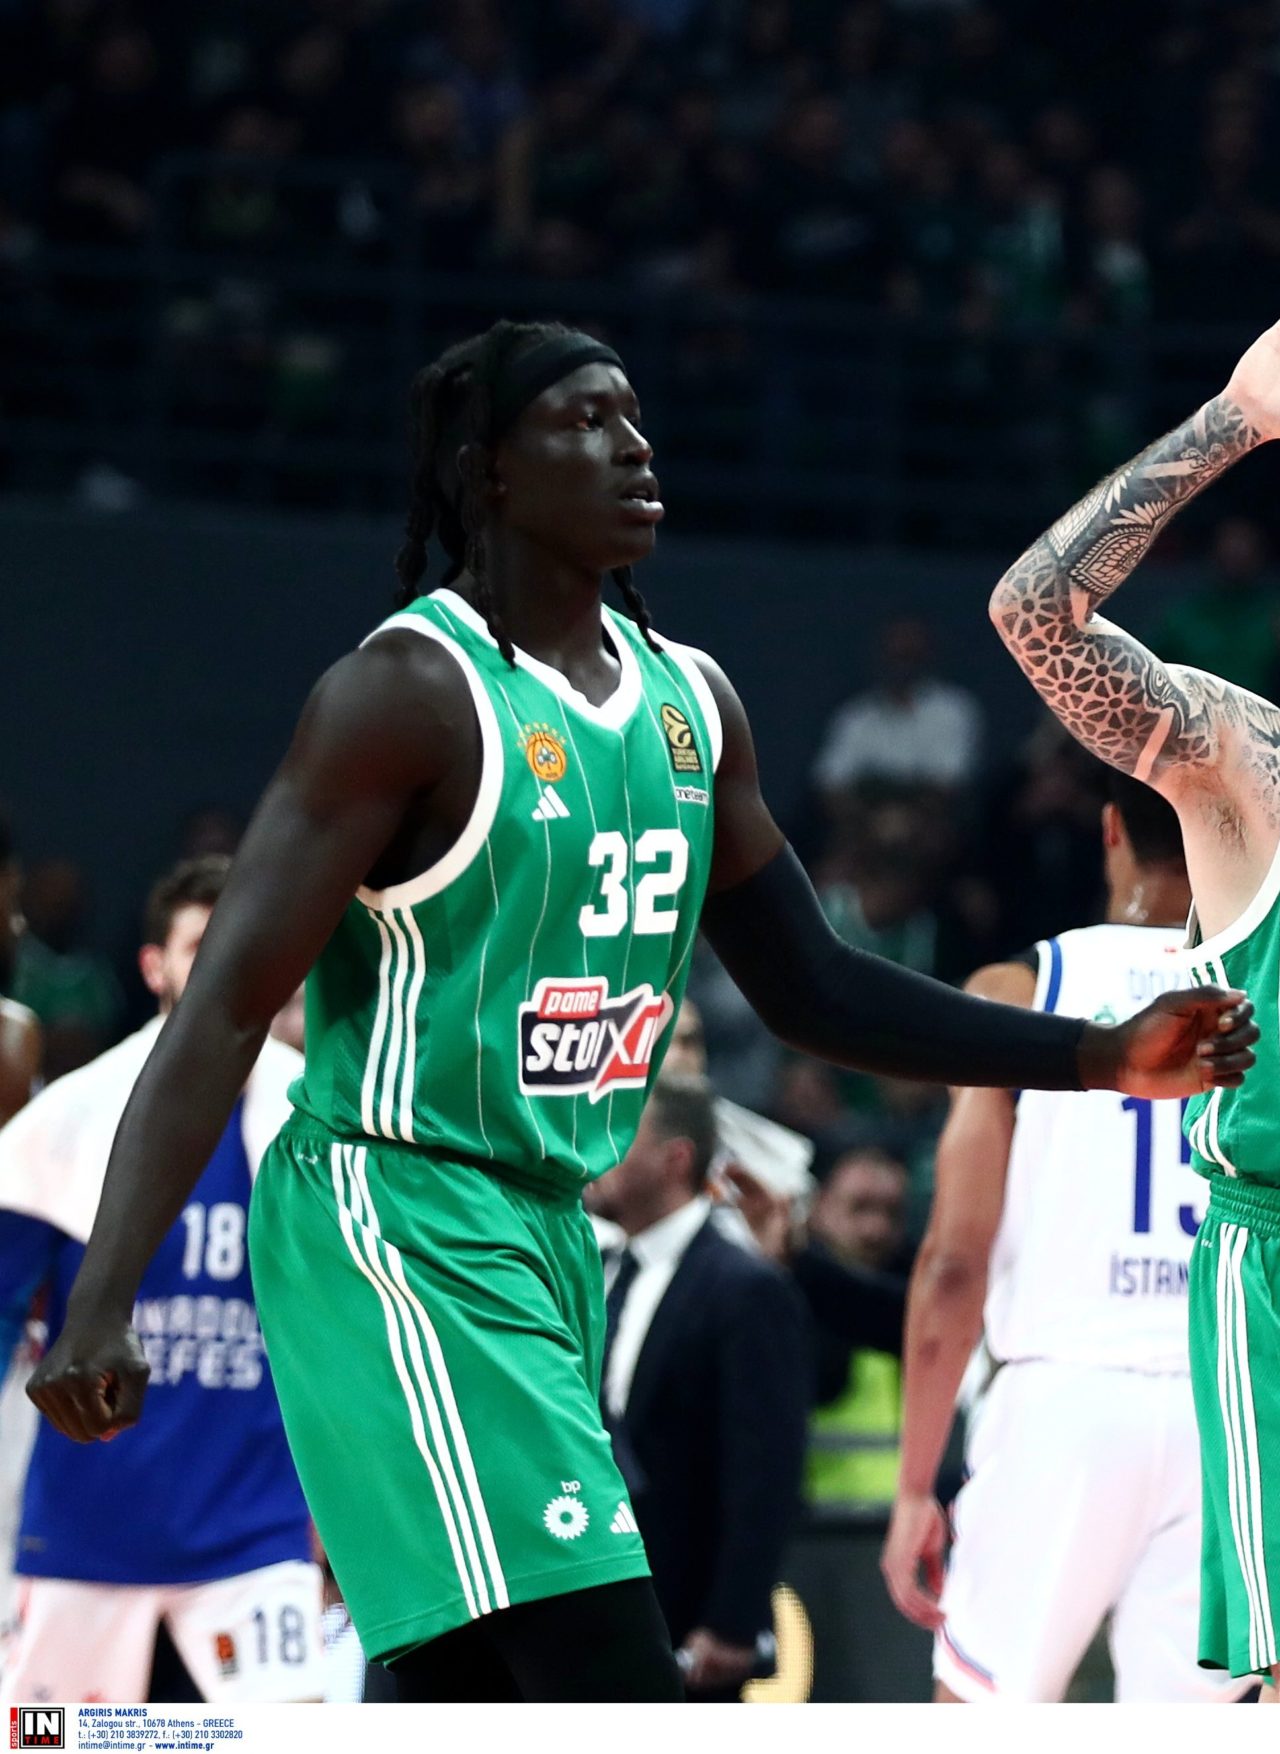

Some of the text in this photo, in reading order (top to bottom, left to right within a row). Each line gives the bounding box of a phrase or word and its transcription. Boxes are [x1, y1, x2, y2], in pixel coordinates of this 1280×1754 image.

[578, 828, 689, 937] 32
[544, 990, 600, 1015] pame
[181, 1202, 246, 1281] 18
[560, 1480, 581, 1494] bp
[252, 1605, 307, 1665] 18
